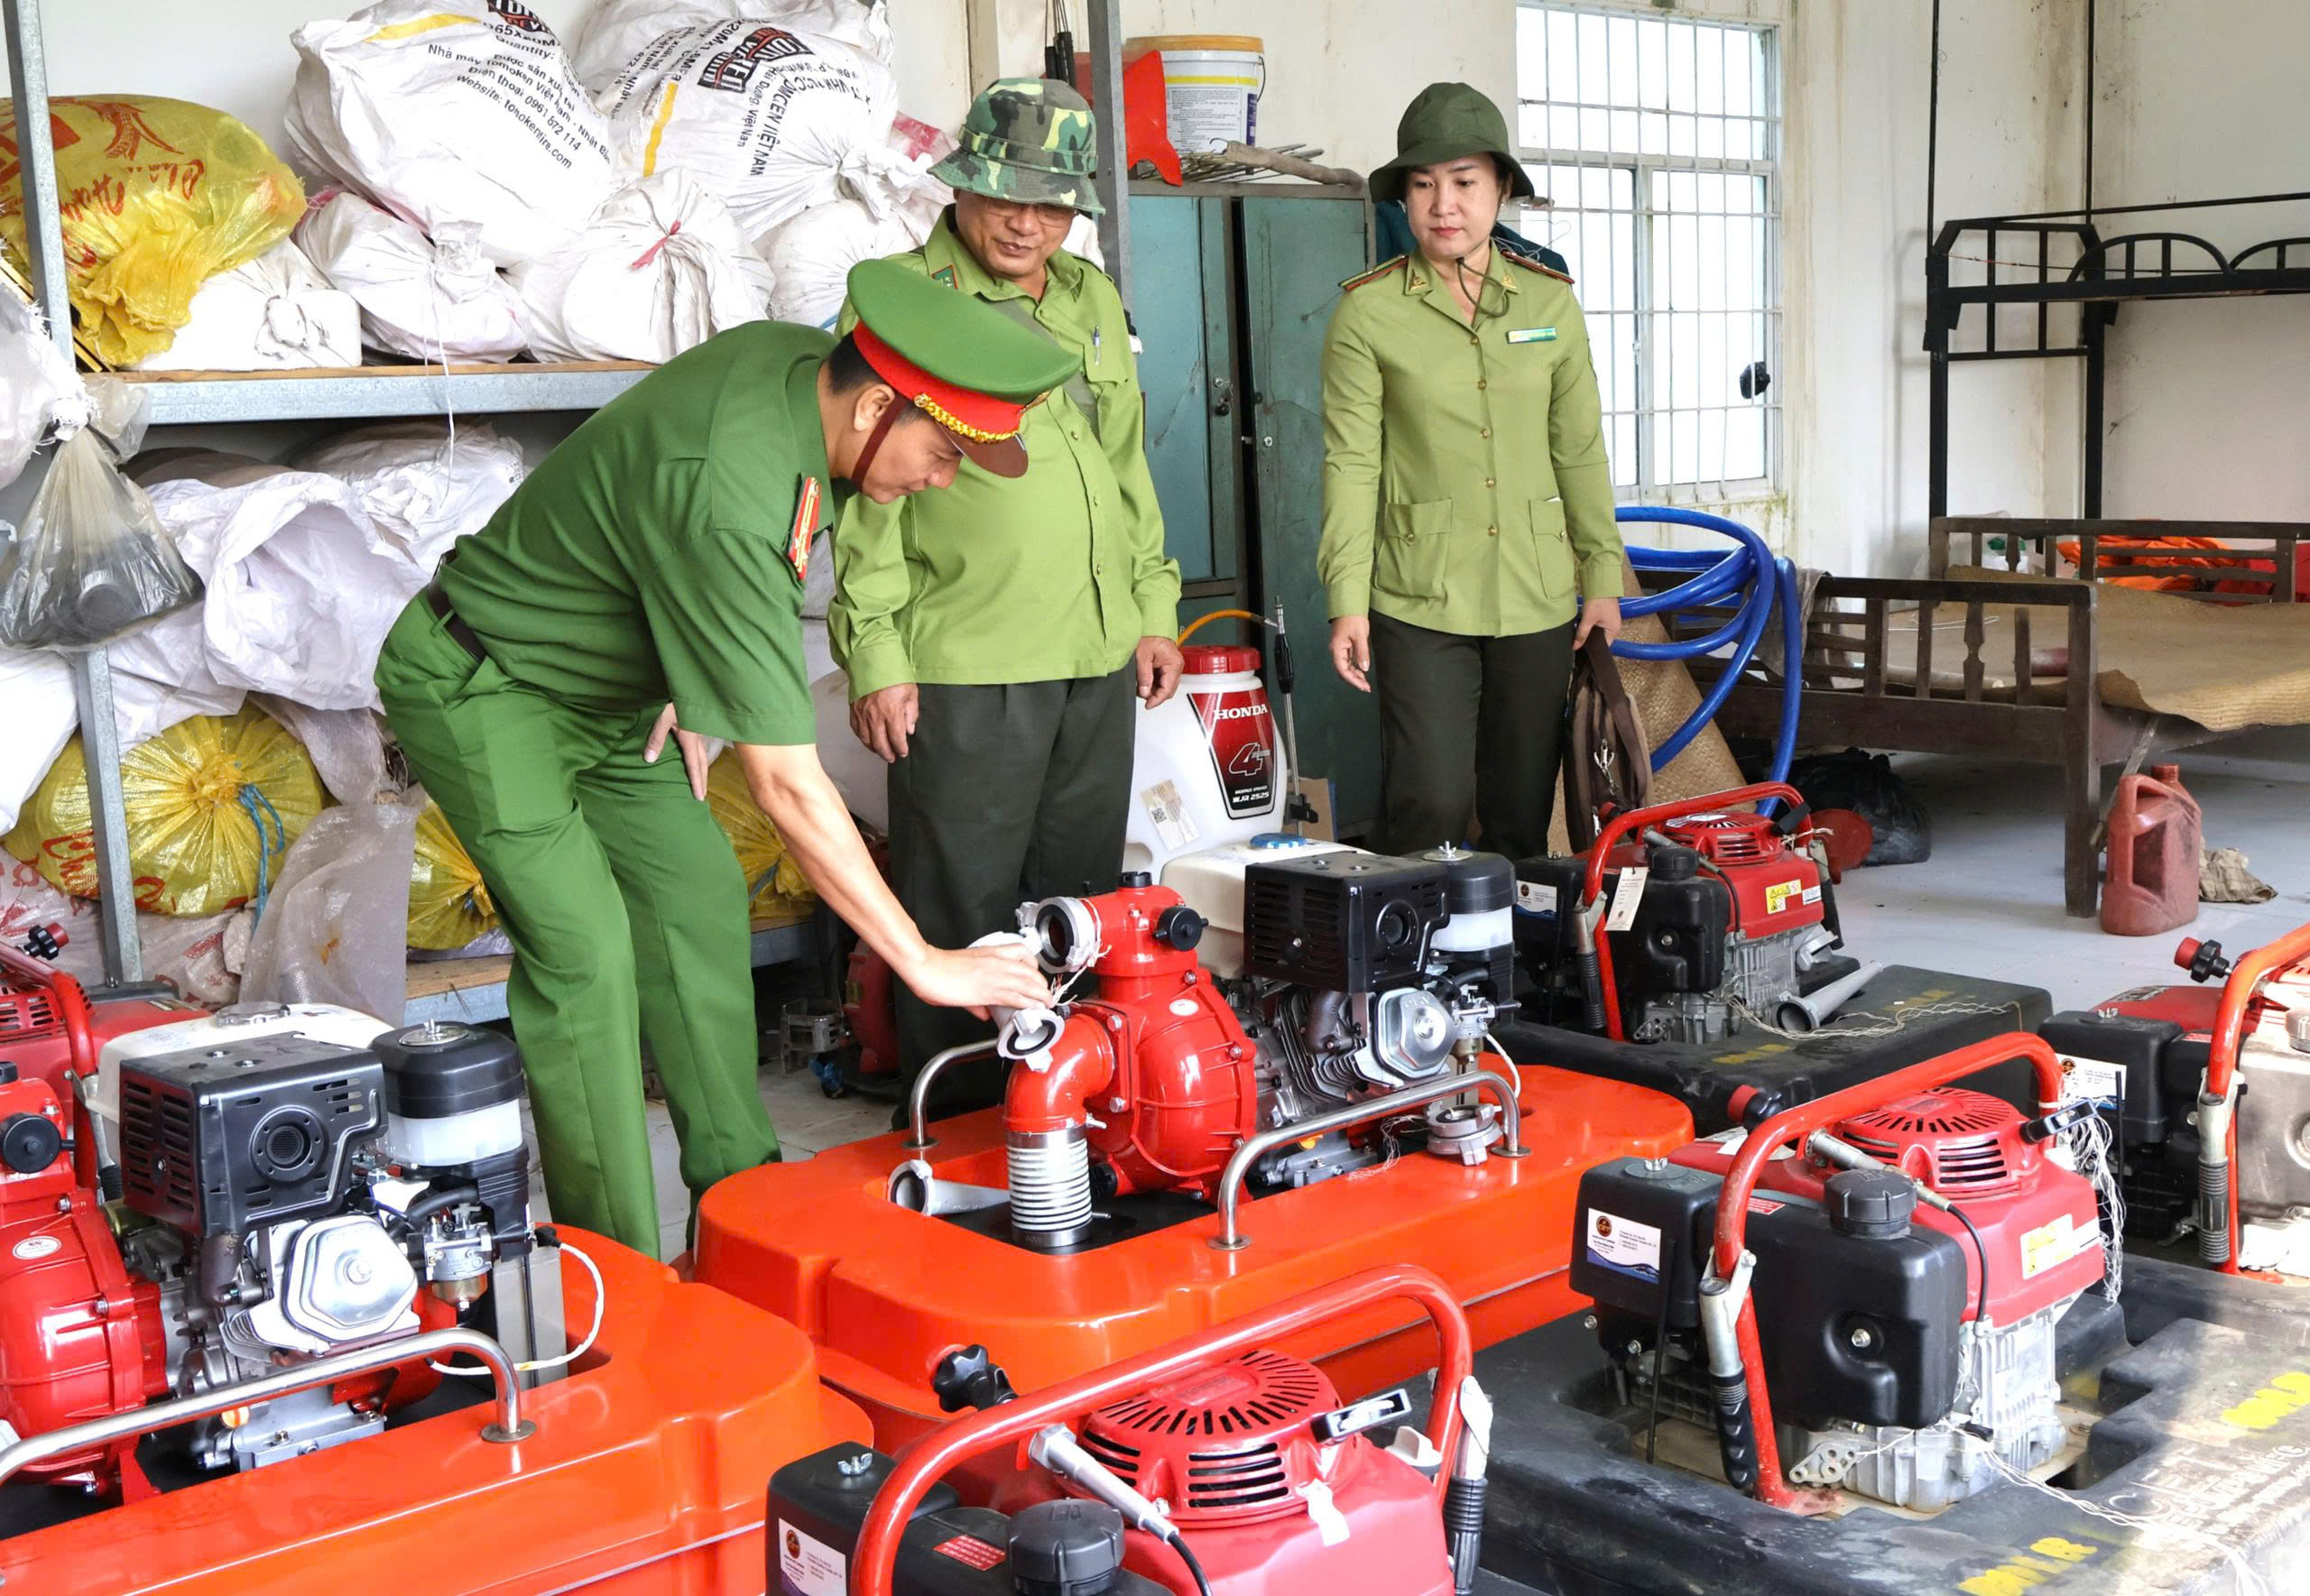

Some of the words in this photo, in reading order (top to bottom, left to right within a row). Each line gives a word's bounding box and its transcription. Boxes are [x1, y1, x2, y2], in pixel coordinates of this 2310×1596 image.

[528, 64, 547, 79] sản
[457, 75, 503, 104] Website:
[524, 96, 549, 117] 0961
[563, 133, 582, 151] 114
[536, 81, 554, 101] Việt
[578, 125, 597, 148] Nhật
[1214, 704, 1268, 720] HONDA
[1233, 795, 1250, 804] WJR
[1251, 791, 1270, 801] 2525
